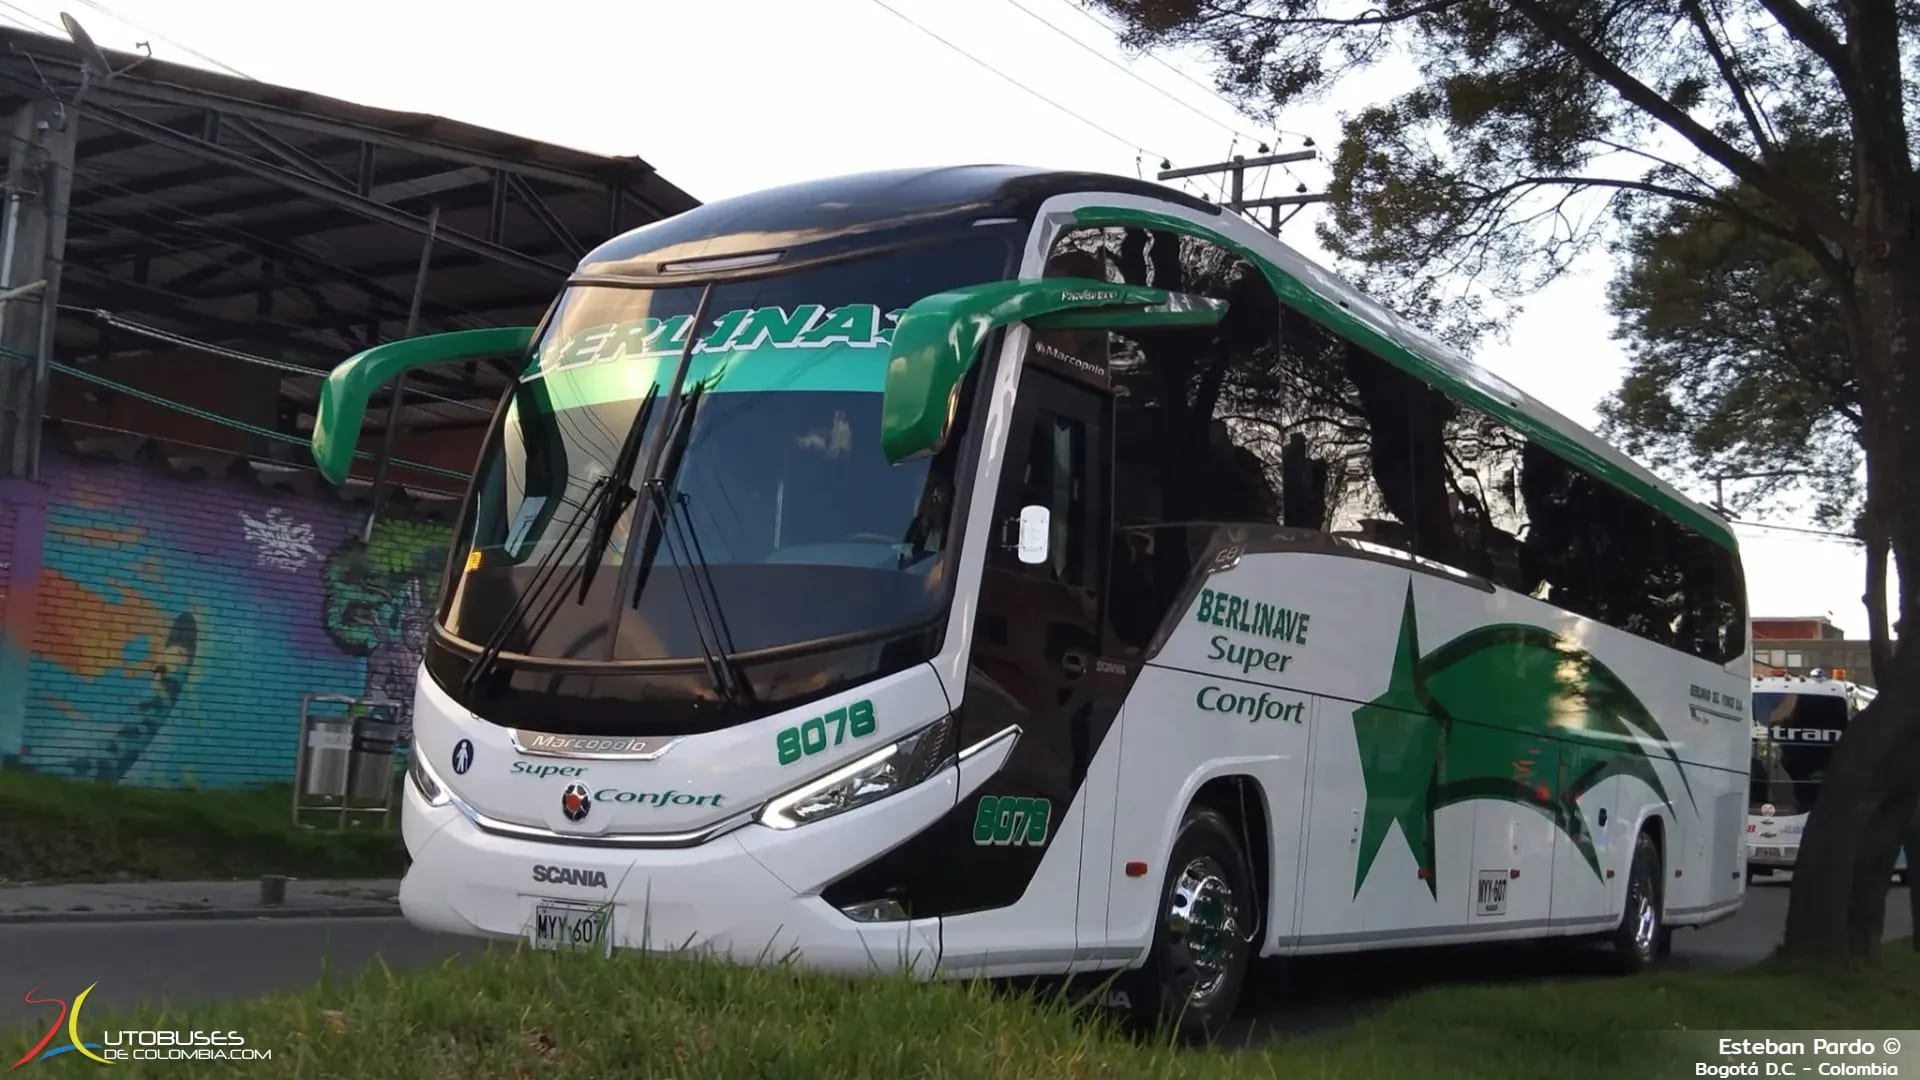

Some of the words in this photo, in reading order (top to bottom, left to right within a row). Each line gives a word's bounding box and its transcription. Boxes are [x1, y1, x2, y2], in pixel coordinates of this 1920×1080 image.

[1046, 344, 1105, 376] Marcopolo
[1197, 588, 1310, 645] BERLINAVE
[1207, 635, 1292, 673] Super
[1196, 686, 1305, 723] Confort
[532, 735, 646, 751] Marcopolo
[776, 699, 876, 766] 8078
[510, 761, 588, 778] Super
[593, 788, 727, 807] Confort
[973, 796, 1051, 846] 8078
[533, 864, 608, 889] SCANIA
